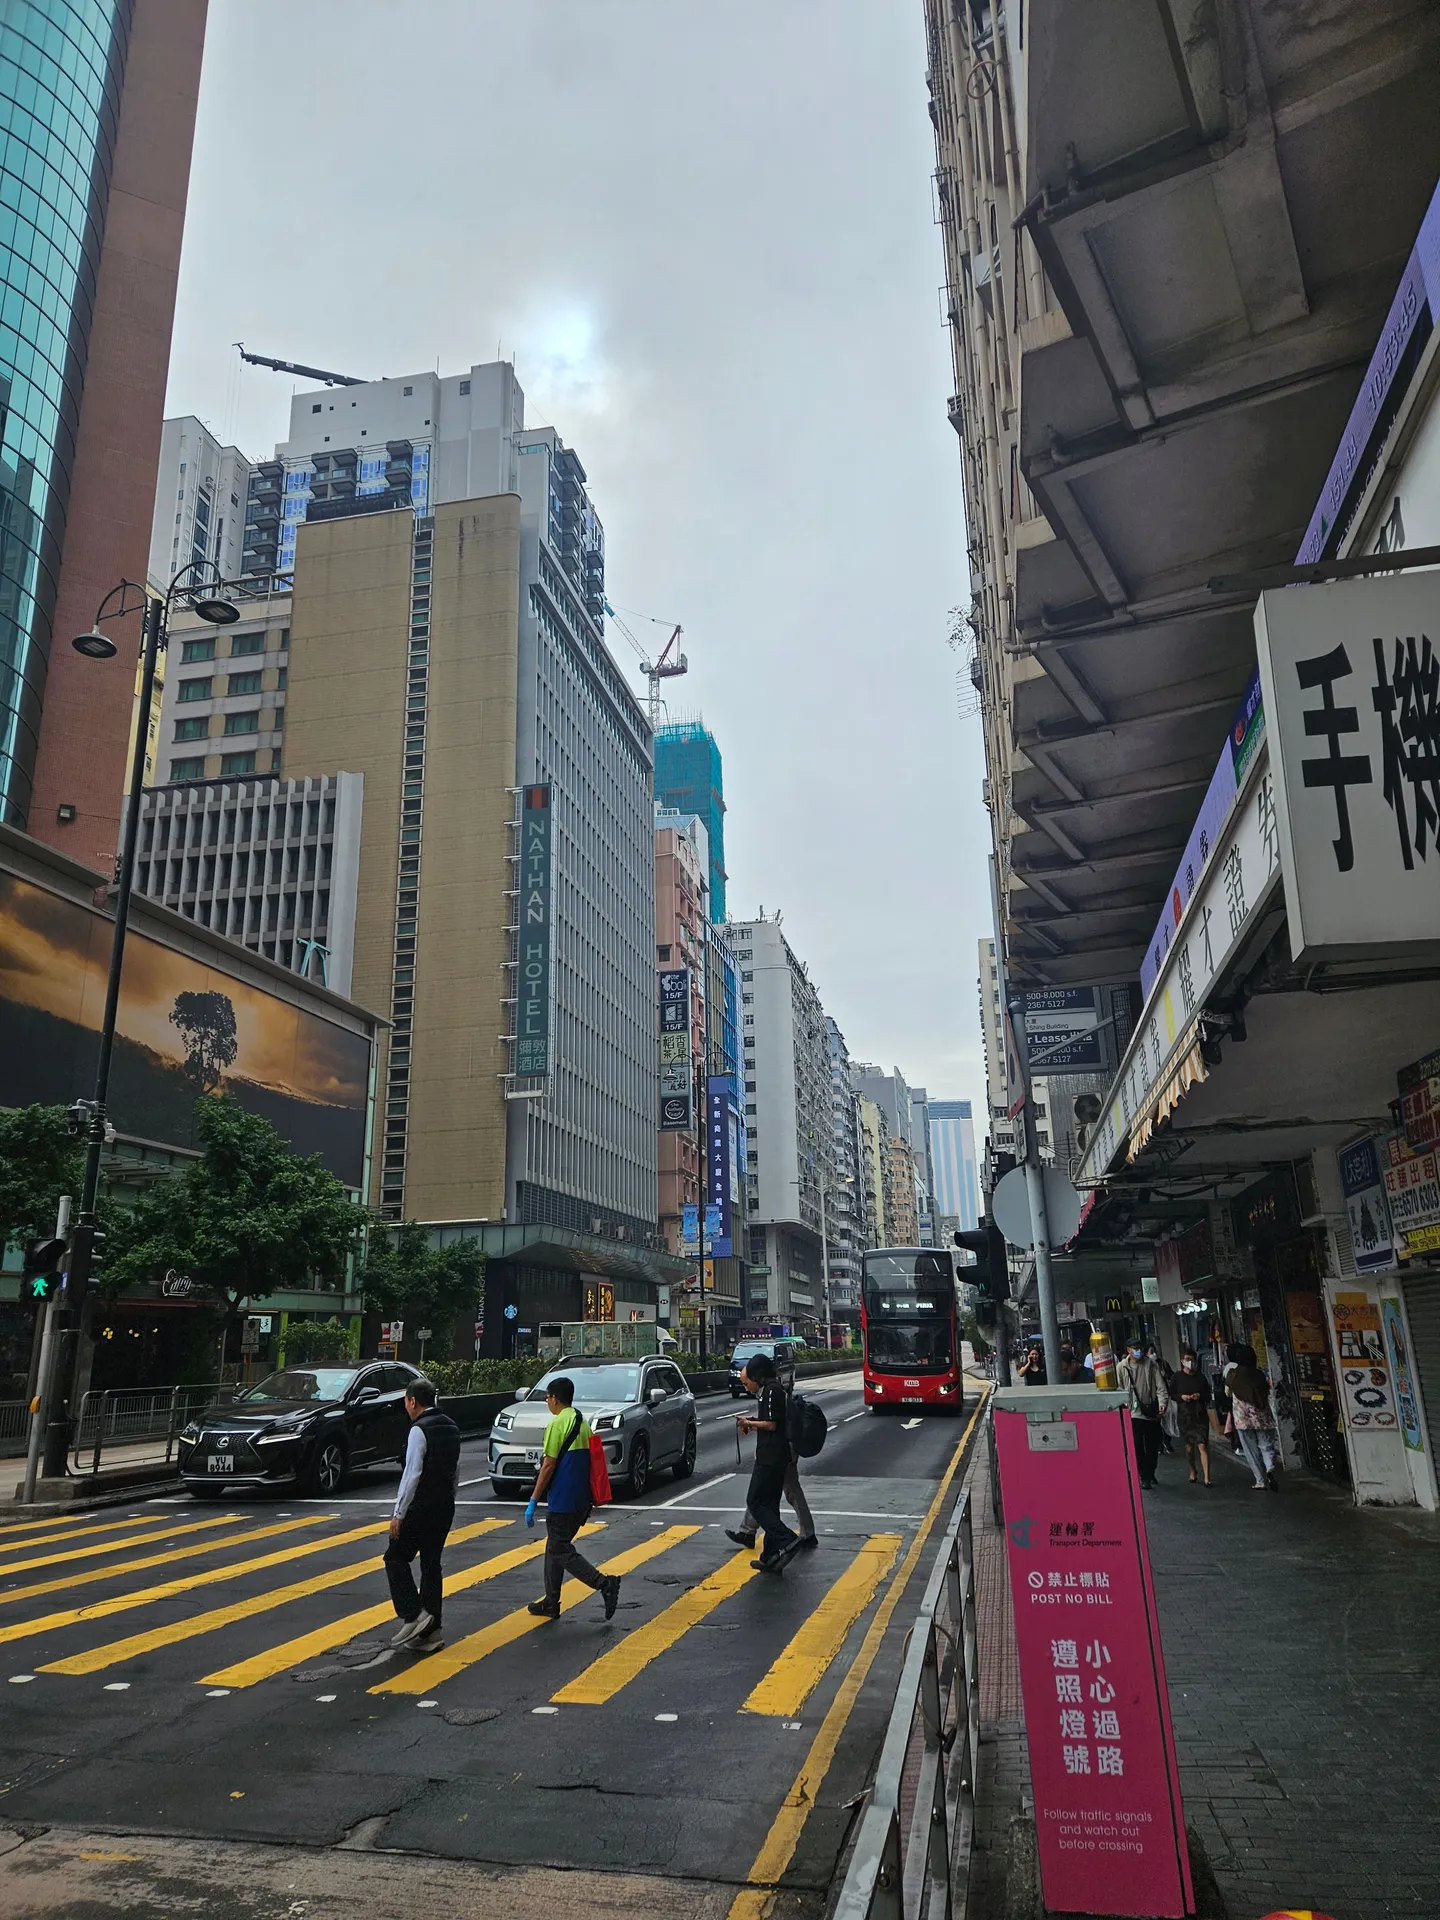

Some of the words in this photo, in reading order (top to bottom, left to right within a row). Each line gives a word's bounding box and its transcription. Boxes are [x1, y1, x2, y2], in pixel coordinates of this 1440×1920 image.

[1296, 633, 1440, 873] 手機
[527, 820, 545, 924] NATHAN
[525, 943, 543, 1034] HOTEL
[664, 992, 683, 1000] 15/F
[1027, 1001, 1045, 1009] 2367
[1047, 1000, 1065, 1008] 5127
[518, 1038, 547, 1055] 彌敦
[663, 1035, 687, 1049] 稻香
[1034, 1035, 1068, 1044] Lease
[518, 1055, 546, 1073] 酒店
[1053, 1055, 1071, 1063] 5127
[528, 1451, 539, 1460] SA
[1049, 1522, 1095, 1537] 運輸署
[1049, 1539, 1081, 1548] Transport
[1082, 1538, 1122, 1547] Department
[1047, 1571, 1110, 1588] 禁止標貼
[1031, 1593, 1062, 1604] POST
[1065, 1593, 1083, 1604] NO
[1087, 1593, 1113, 1605] BILL
[1051, 1639, 1092, 1775] 遵照燈號
[1085, 1639, 1125, 1776] 小心過路
[1043, 1808, 1078, 1820] Follow
[1080, 1809, 1112, 1822] traffic
[1115, 1810, 1153, 1824] signals
[1059, 1824, 1082, 1835] and
[1084, 1825, 1118, 1837] watch
[1121, 1825, 1140, 1837] out
[1059, 1838, 1096, 1850] before
[1098, 1839, 1144, 1854] crossing
